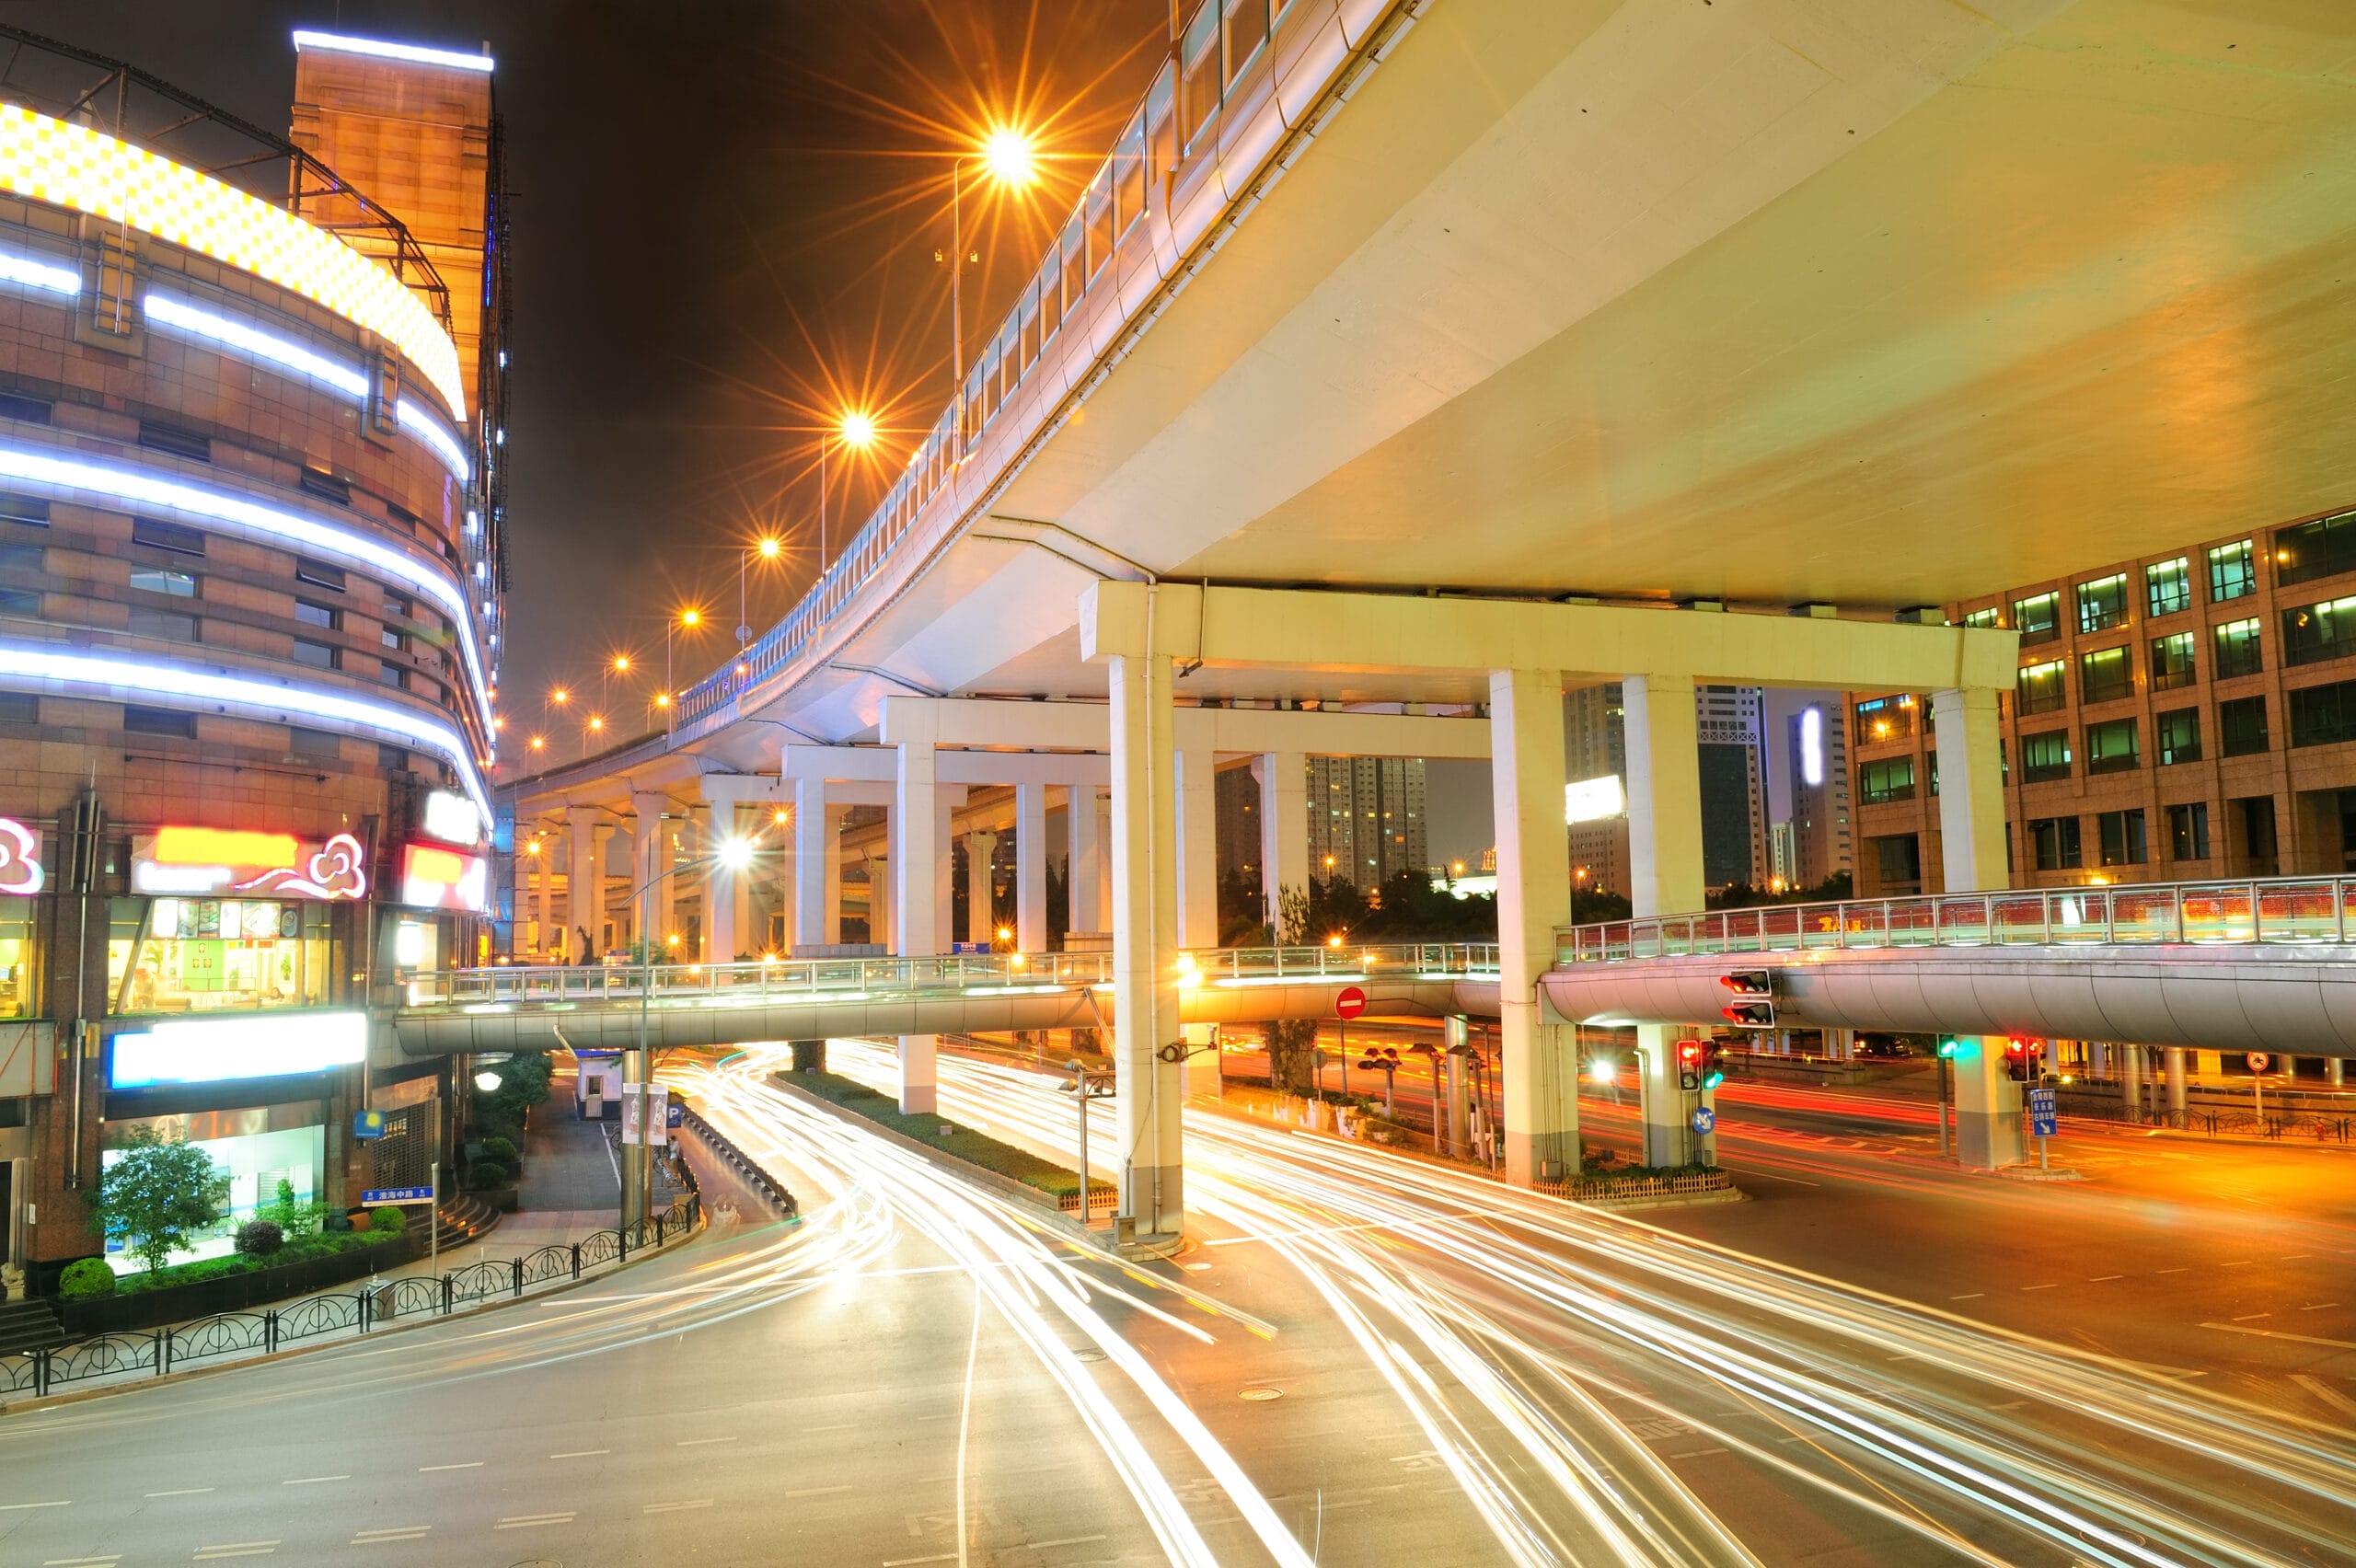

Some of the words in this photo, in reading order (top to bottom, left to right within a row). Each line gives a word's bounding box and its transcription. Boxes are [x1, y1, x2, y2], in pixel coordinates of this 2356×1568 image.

[669, 1108, 679, 1118] P
[379, 1190, 413, 1199] 淮海中路
